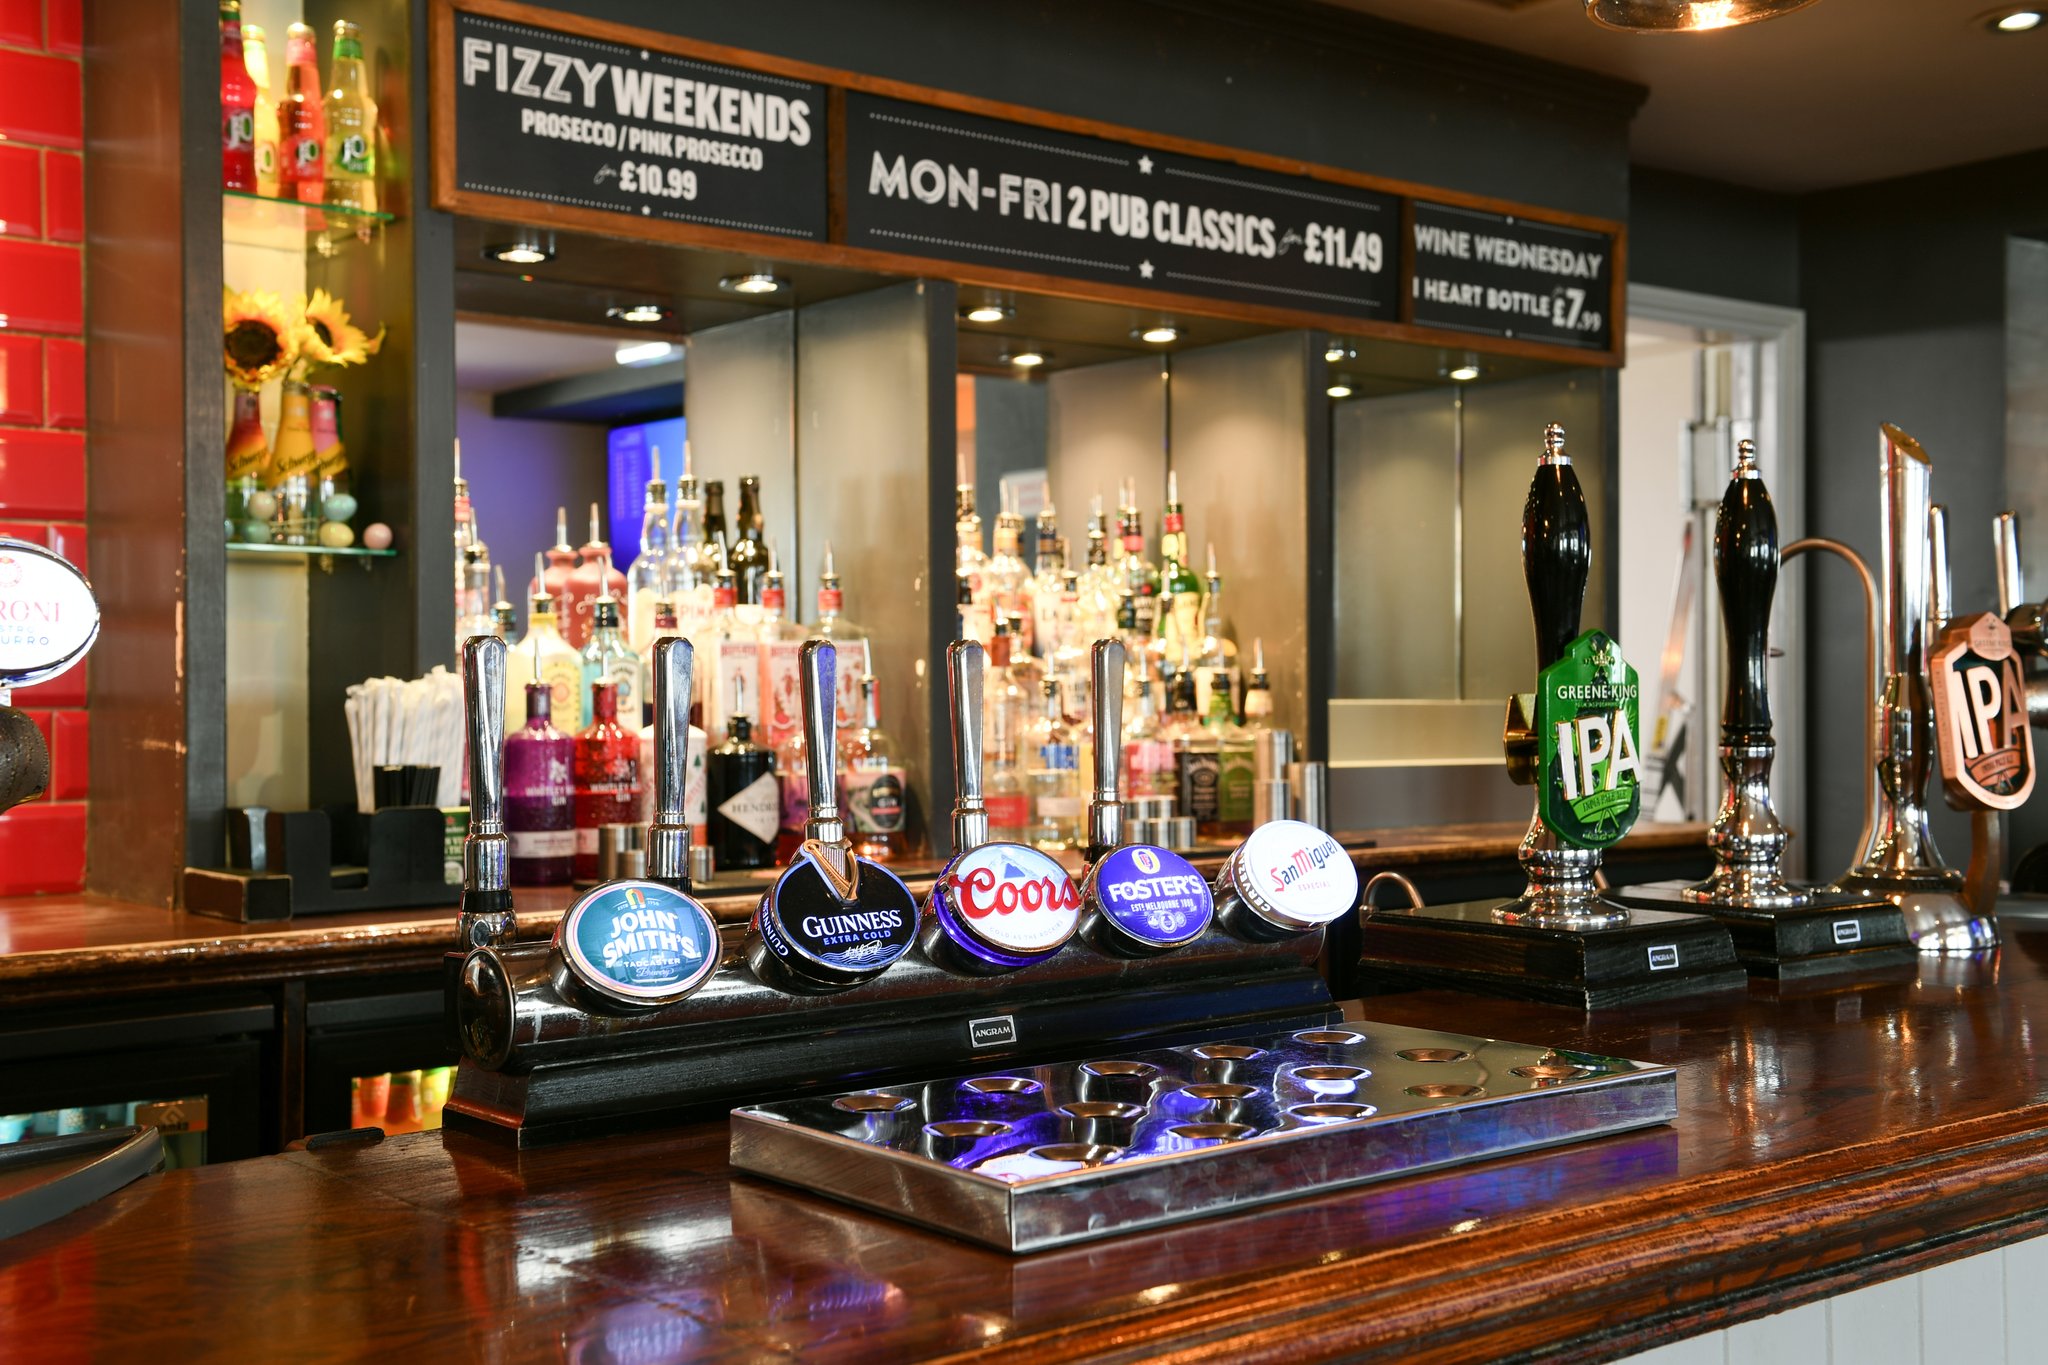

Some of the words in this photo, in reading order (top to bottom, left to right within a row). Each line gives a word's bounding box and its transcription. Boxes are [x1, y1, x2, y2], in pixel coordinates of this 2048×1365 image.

[462, 36, 608, 108] FIZZY
[610, 65, 811, 147] WEEKENDS
[521, 108, 617, 148] PROSECCO
[628, 126, 673, 158] PINK
[674, 134, 763, 171] PROSECCO
[619, 160, 698, 201] £10.99
[868, 150, 1062, 225] MON-FRI
[1067, 185, 1087, 230] 2
[1090, 189, 1150, 239] PUB
[1152, 200, 1277, 259] CLASSICS
[1303, 222, 1383, 273] £11.49
[1413, 224, 1471, 259] WINE
[1474, 235, 1602, 278] WEDNESDAY
[1424, 278, 1483, 307] HEART
[1486, 287, 1550, 317] BOTTLE
[1557, 685, 1608, 699] GREENE
[1611, 684, 1637, 699] KING
[1950, 660, 2027, 759] IPA
[1556, 709, 1643, 801] IPA
[948, 867, 1082, 919] Coors
[1108, 875, 1203, 902] FOSTER'S
[610, 909, 679, 939] JOHN
[802, 909, 902, 938] GUINNESS
[823, 931, 860, 946] EXTRA
[863, 930, 892, 940] COLD
[602, 931, 701, 968] SMITH'S
[623, 958, 681, 968] TADCASTER
[975, 1026, 1011, 1038] ANGRAM
